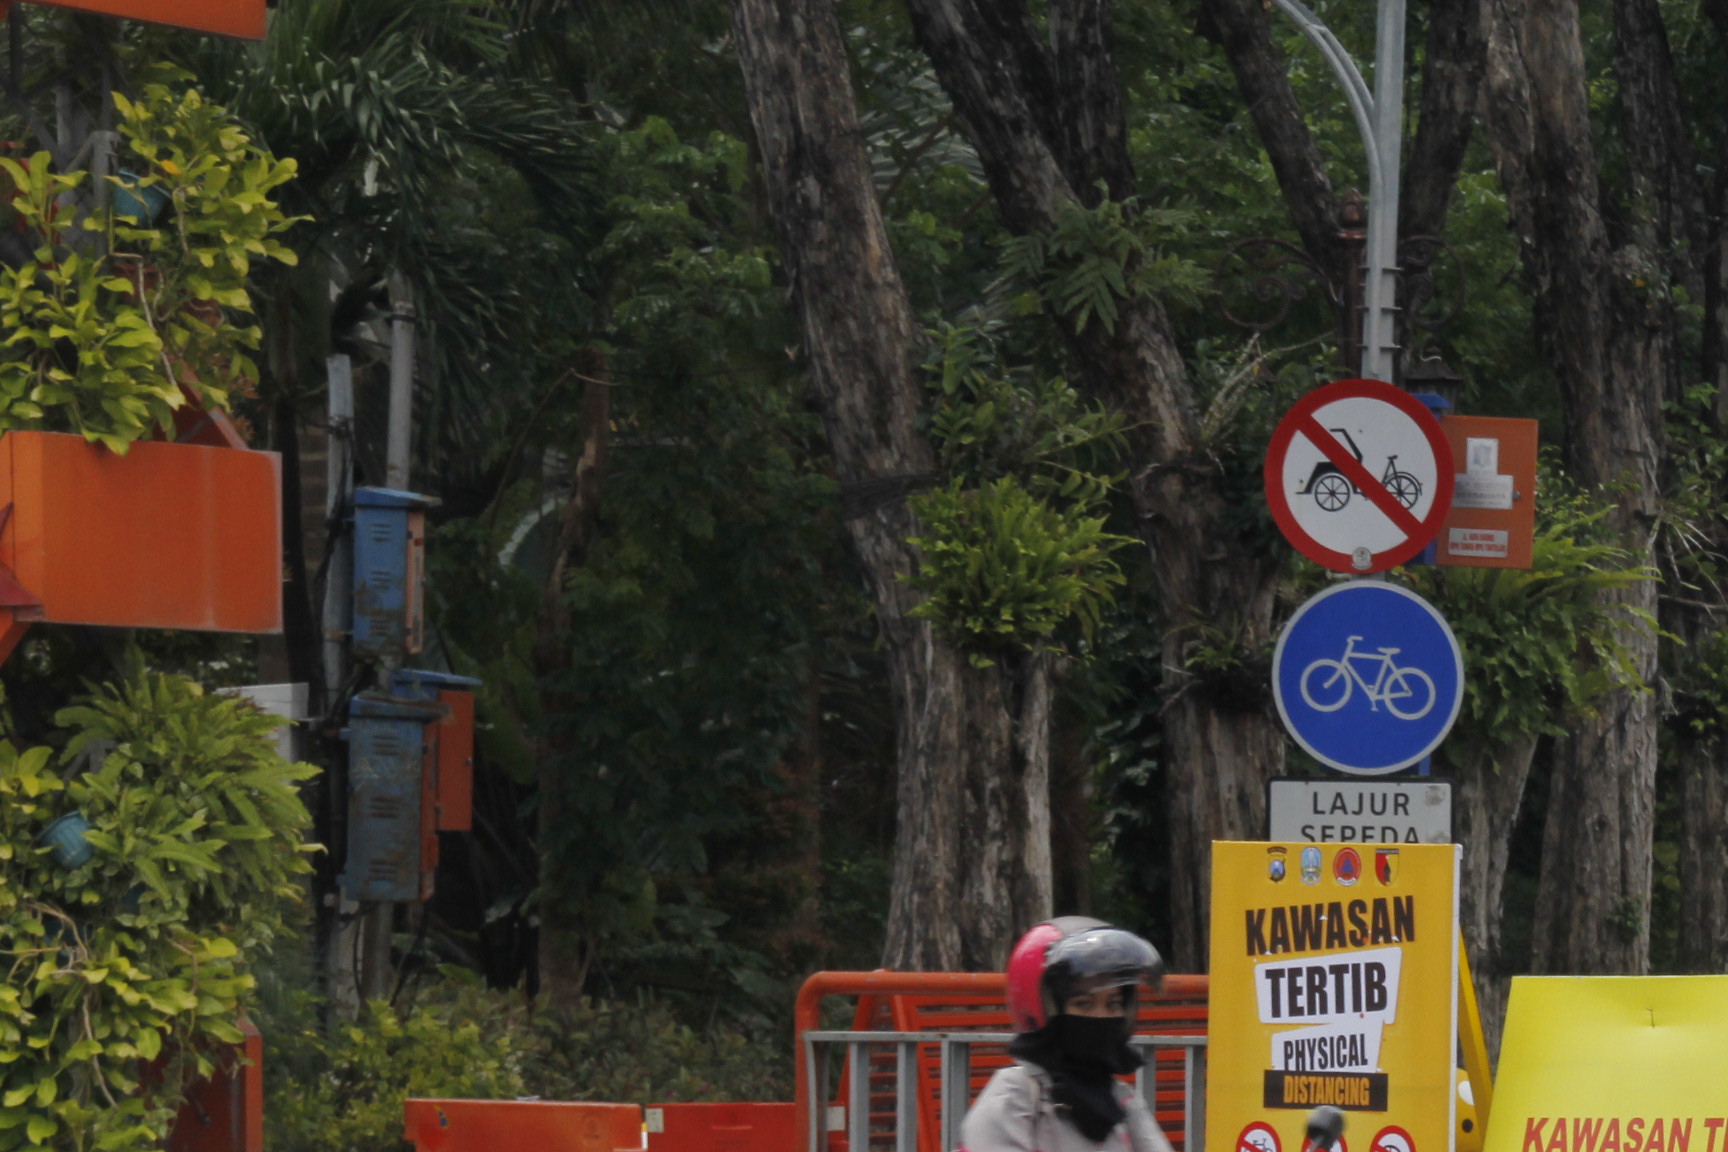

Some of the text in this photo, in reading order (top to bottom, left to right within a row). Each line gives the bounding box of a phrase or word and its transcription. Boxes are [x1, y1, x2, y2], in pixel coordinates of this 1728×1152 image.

[1312, 792, 1411, 816] LAJUR
[1300, 825, 1421, 843] SEPEDA
[1245, 895, 1416, 957] KAWASAN
[1265, 961, 1388, 1019] TERTIB
[1283, 1031, 1369, 1072] PHYSICAL
[1283, 1075, 1371, 1108] DISTANCING
